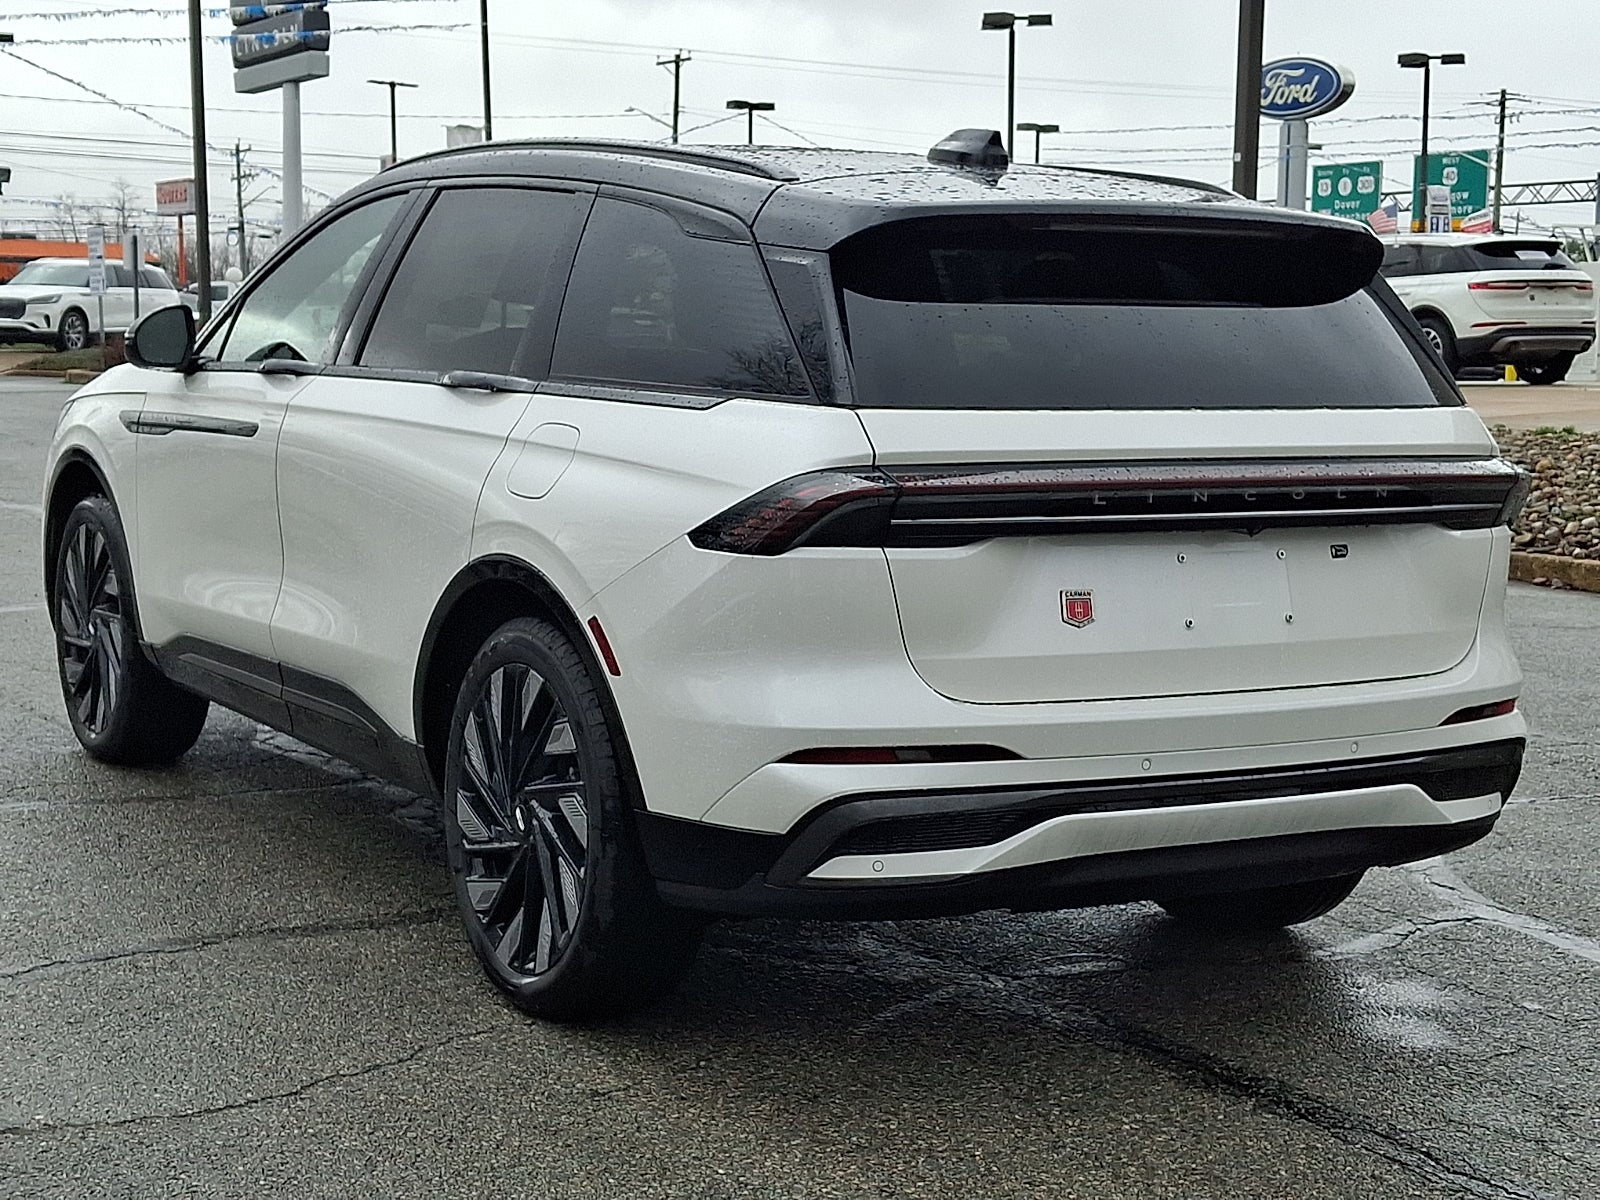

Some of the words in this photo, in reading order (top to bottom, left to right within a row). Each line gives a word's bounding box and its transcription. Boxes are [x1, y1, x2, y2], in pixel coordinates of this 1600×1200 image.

[235, 23, 299, 57] LINCOLN
[1260, 67, 1320, 106] Ford
[1358, 179, 1373, 191] 301
[1334, 199, 1361, 210] Dover
[1093, 487, 1388, 506] LINCOLN
[1065, 590, 1092, 598] CARMAN
